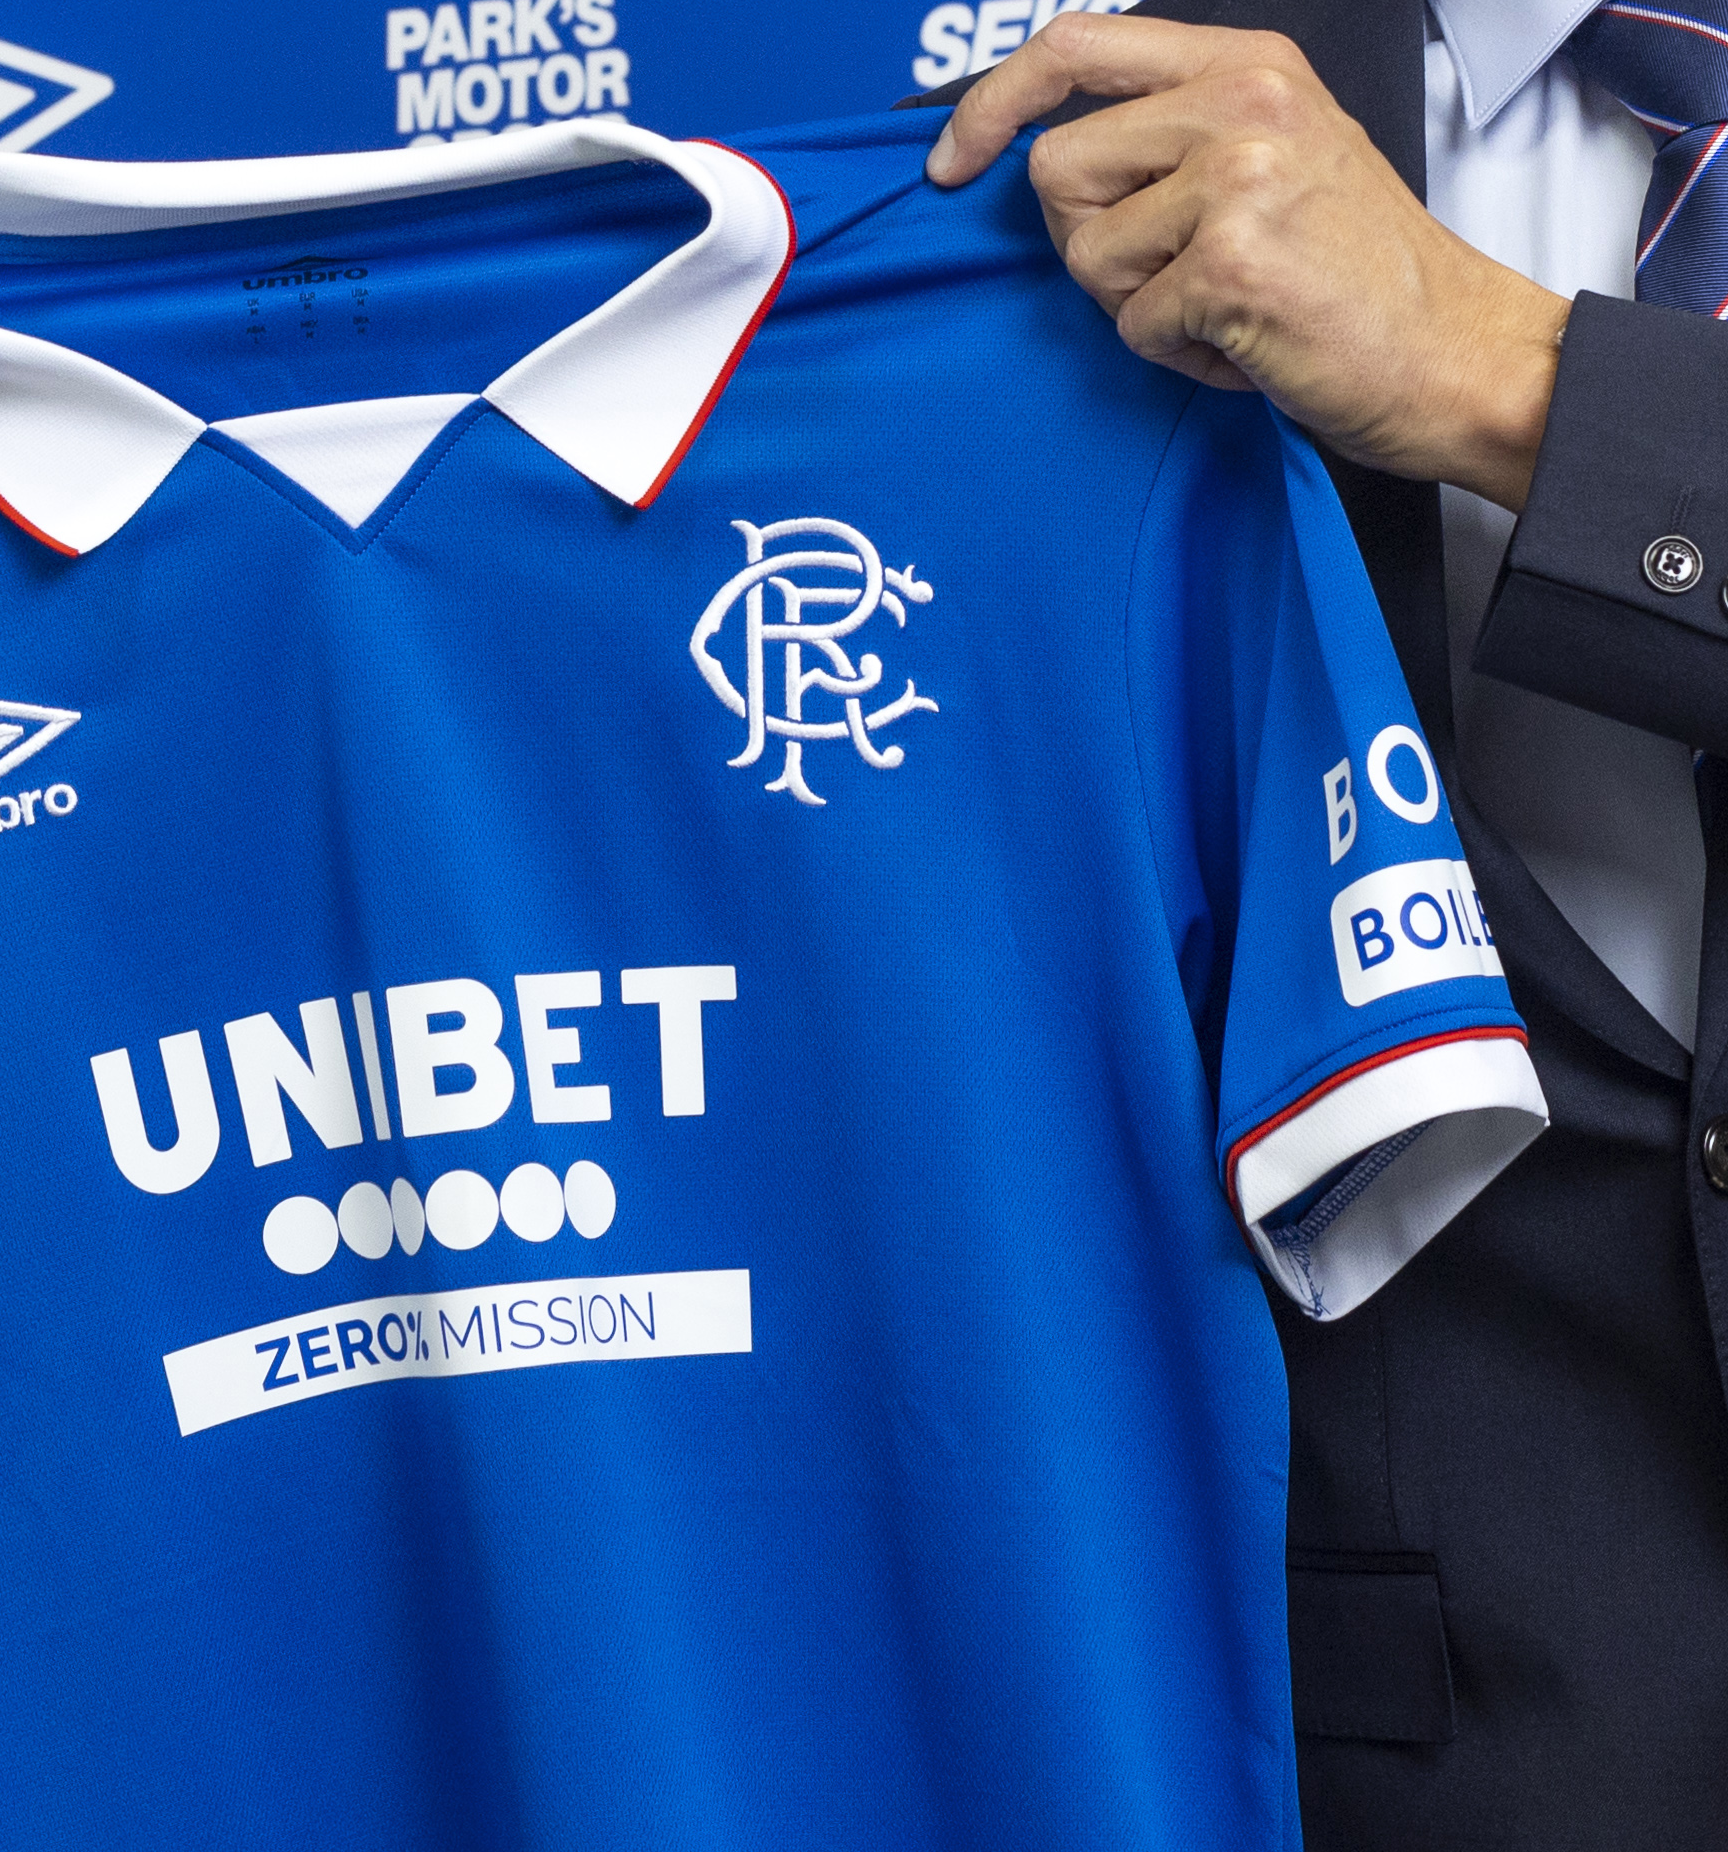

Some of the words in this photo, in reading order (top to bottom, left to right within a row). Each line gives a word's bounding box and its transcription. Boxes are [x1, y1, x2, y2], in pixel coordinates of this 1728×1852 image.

[396, 48, 630, 134] MOTOR
[242, 267, 368, 291] umbro
[1350, 889, 1493, 971] BOILE
[90, 964, 738, 1195] UNIBET
[254, 1310, 430, 1393] ZERO%
[438, 1291, 657, 1360] MISSION
